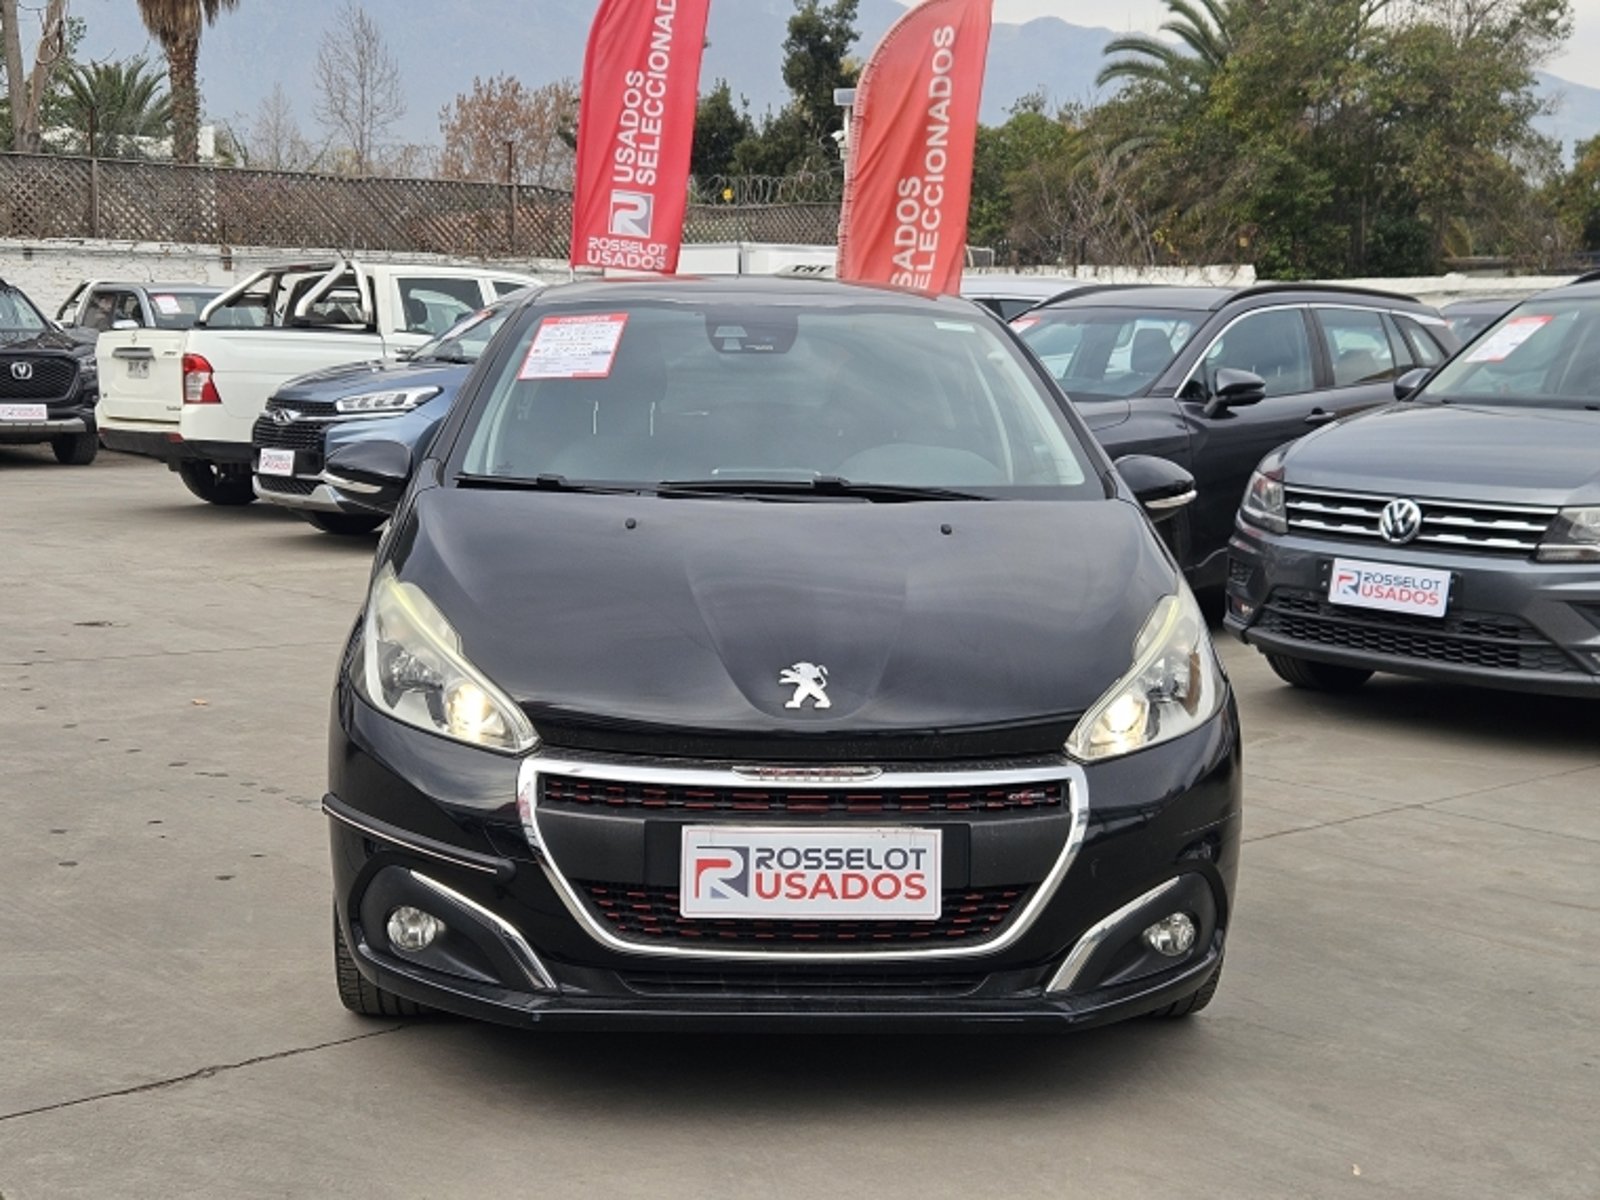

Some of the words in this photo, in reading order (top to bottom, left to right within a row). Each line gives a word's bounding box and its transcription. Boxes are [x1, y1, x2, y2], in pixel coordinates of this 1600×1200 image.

[612, 70, 645, 183] USADOS
[588, 236, 668, 256] ROSSELOT
[586, 249, 666, 270] USADOS
[1362, 571, 1442, 591] ROSSELOT
[1361, 584, 1440, 607] USADOS
[755, 847, 928, 871] ROSSELOT
[755, 872, 928, 901] USADOS
